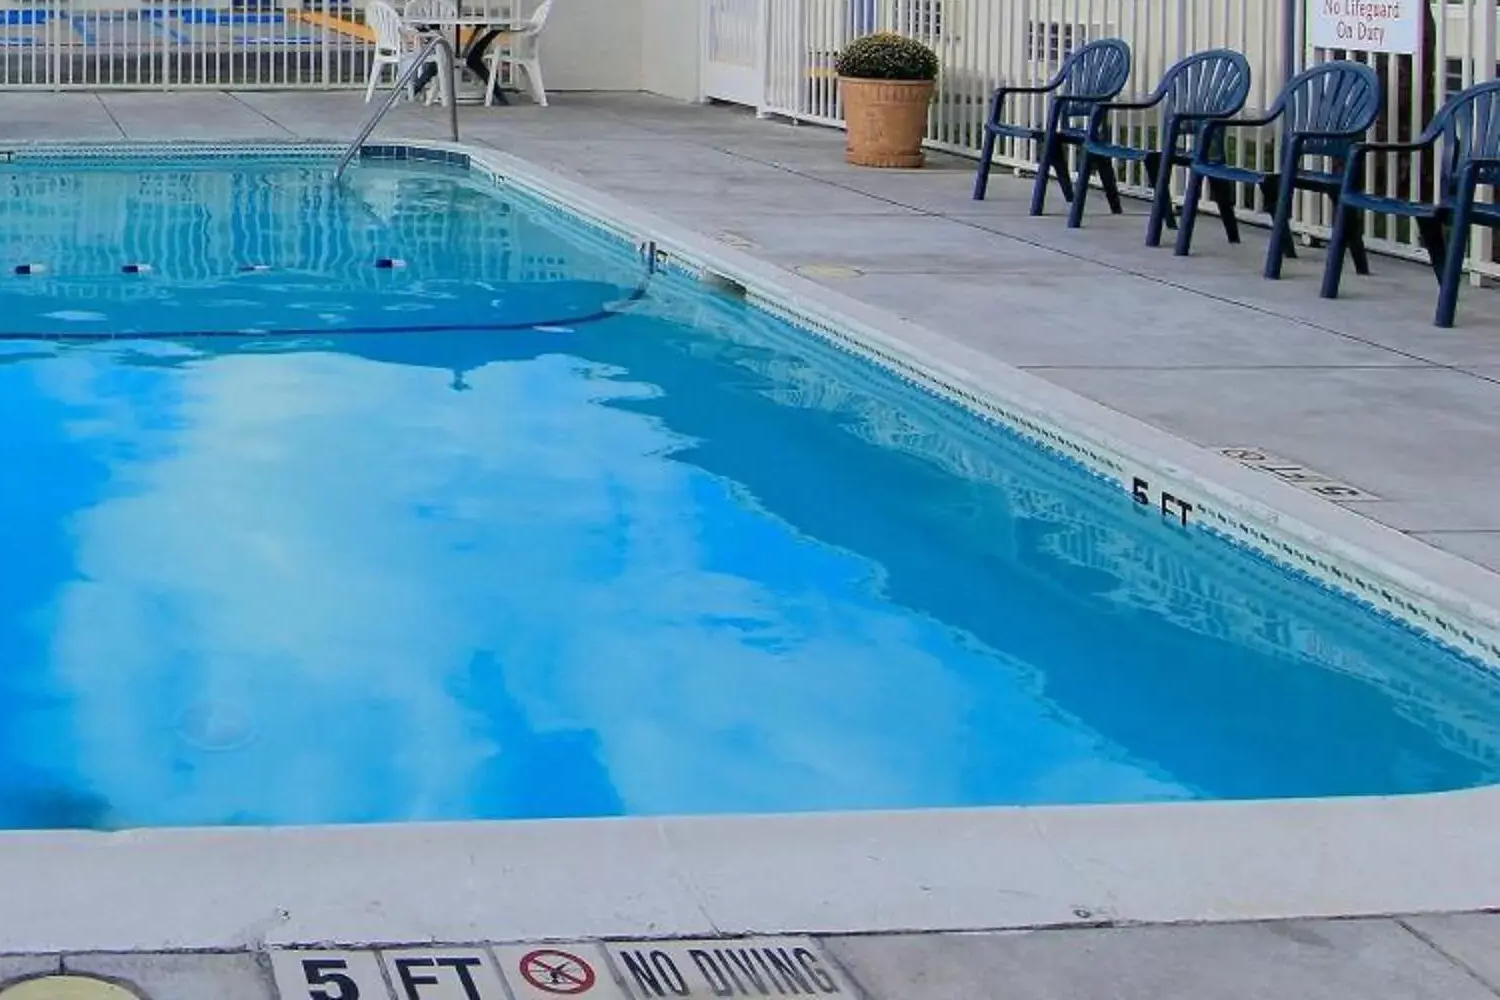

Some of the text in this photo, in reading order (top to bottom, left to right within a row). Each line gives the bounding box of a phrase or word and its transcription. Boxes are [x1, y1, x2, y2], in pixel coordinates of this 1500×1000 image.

[1345, 0, 1400, 21] Lifeguard
[1336, 21, 1385, 44] On Duty
[1132, 476, 1193, 526] 5 FT
[301, 957, 481, 1000] 5 FT
[619, 948, 840, 998] NO DIVING
